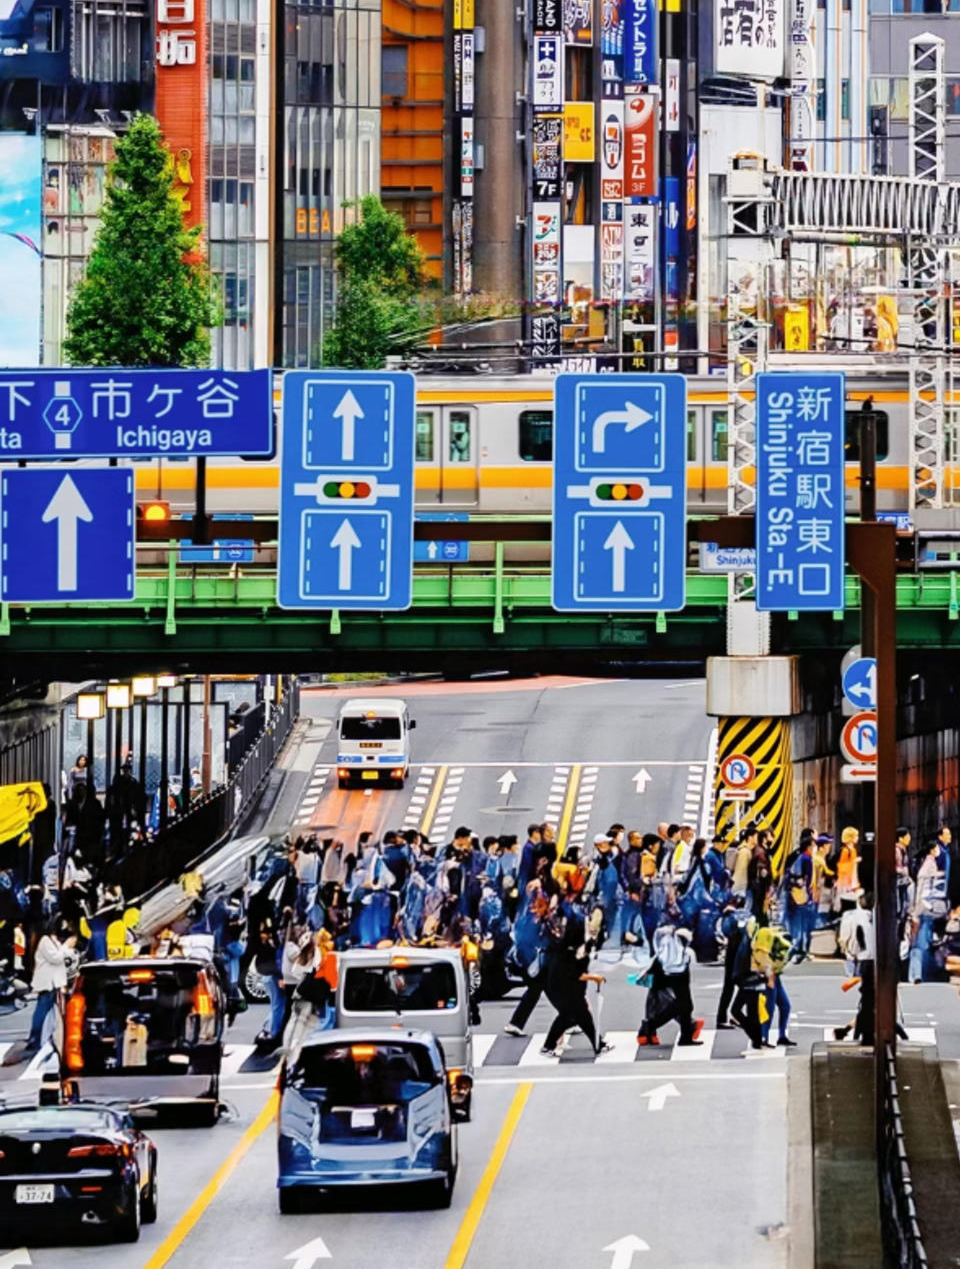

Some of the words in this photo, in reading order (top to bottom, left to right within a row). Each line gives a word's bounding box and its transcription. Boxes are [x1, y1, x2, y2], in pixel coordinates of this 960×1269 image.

[537, 181, 557, 196] 7F
[55, 405, 70, 427] 4
[117, 426, 212, 451] Ichigaya
[763, 391, 794, 497] Shinjuku
[795, 385, 833, 596] 新宿駅東口
